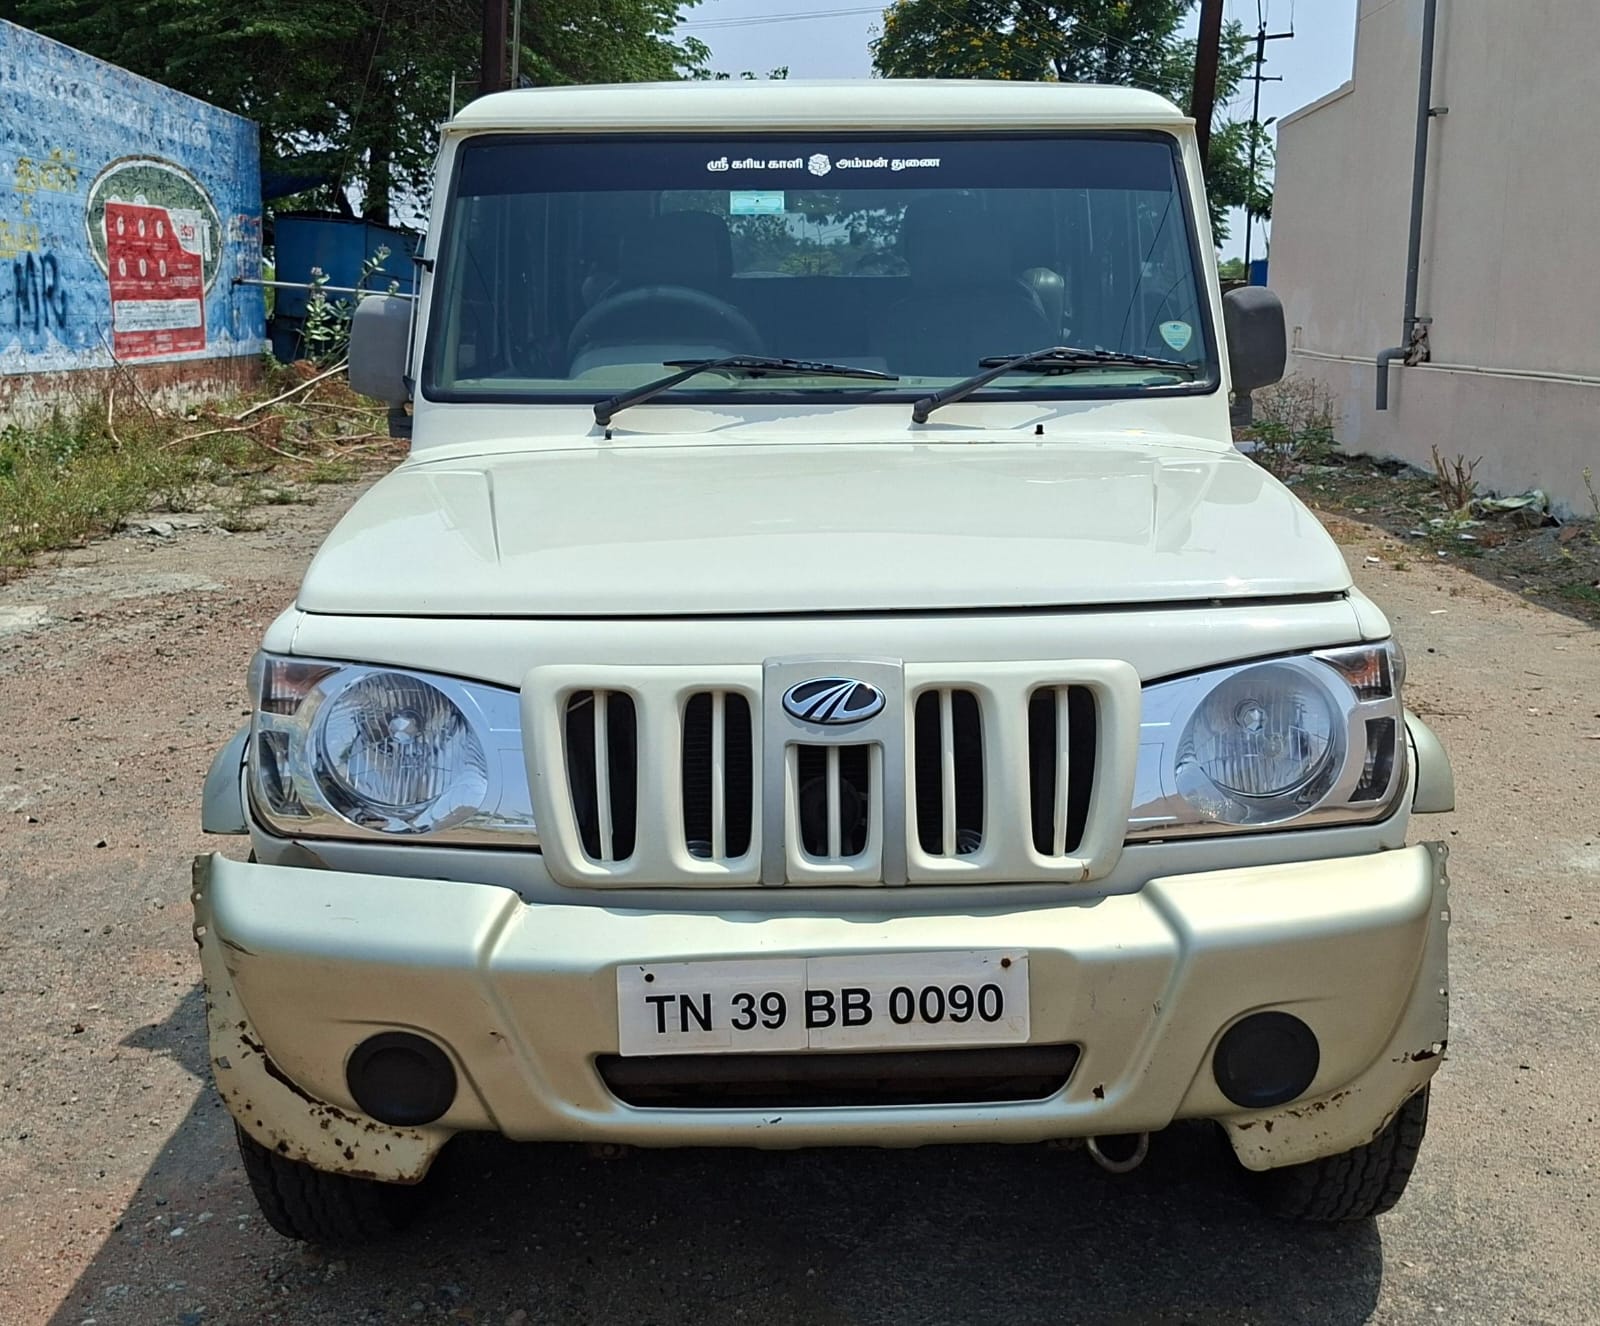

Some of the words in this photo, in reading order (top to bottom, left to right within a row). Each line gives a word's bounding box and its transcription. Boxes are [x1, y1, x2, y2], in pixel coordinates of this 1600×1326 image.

[731, 157, 767, 169] கரிய
[767, 157, 804, 169] காளி
[835, 156, 889, 169] அம்மன்
[890, 157, 941, 172] துணை
[645, 993, 713, 1034] TN
[730, 991, 788, 1031] 39
[804, 987, 873, 1030] BB
[888, 983, 1004, 1025] 0090
